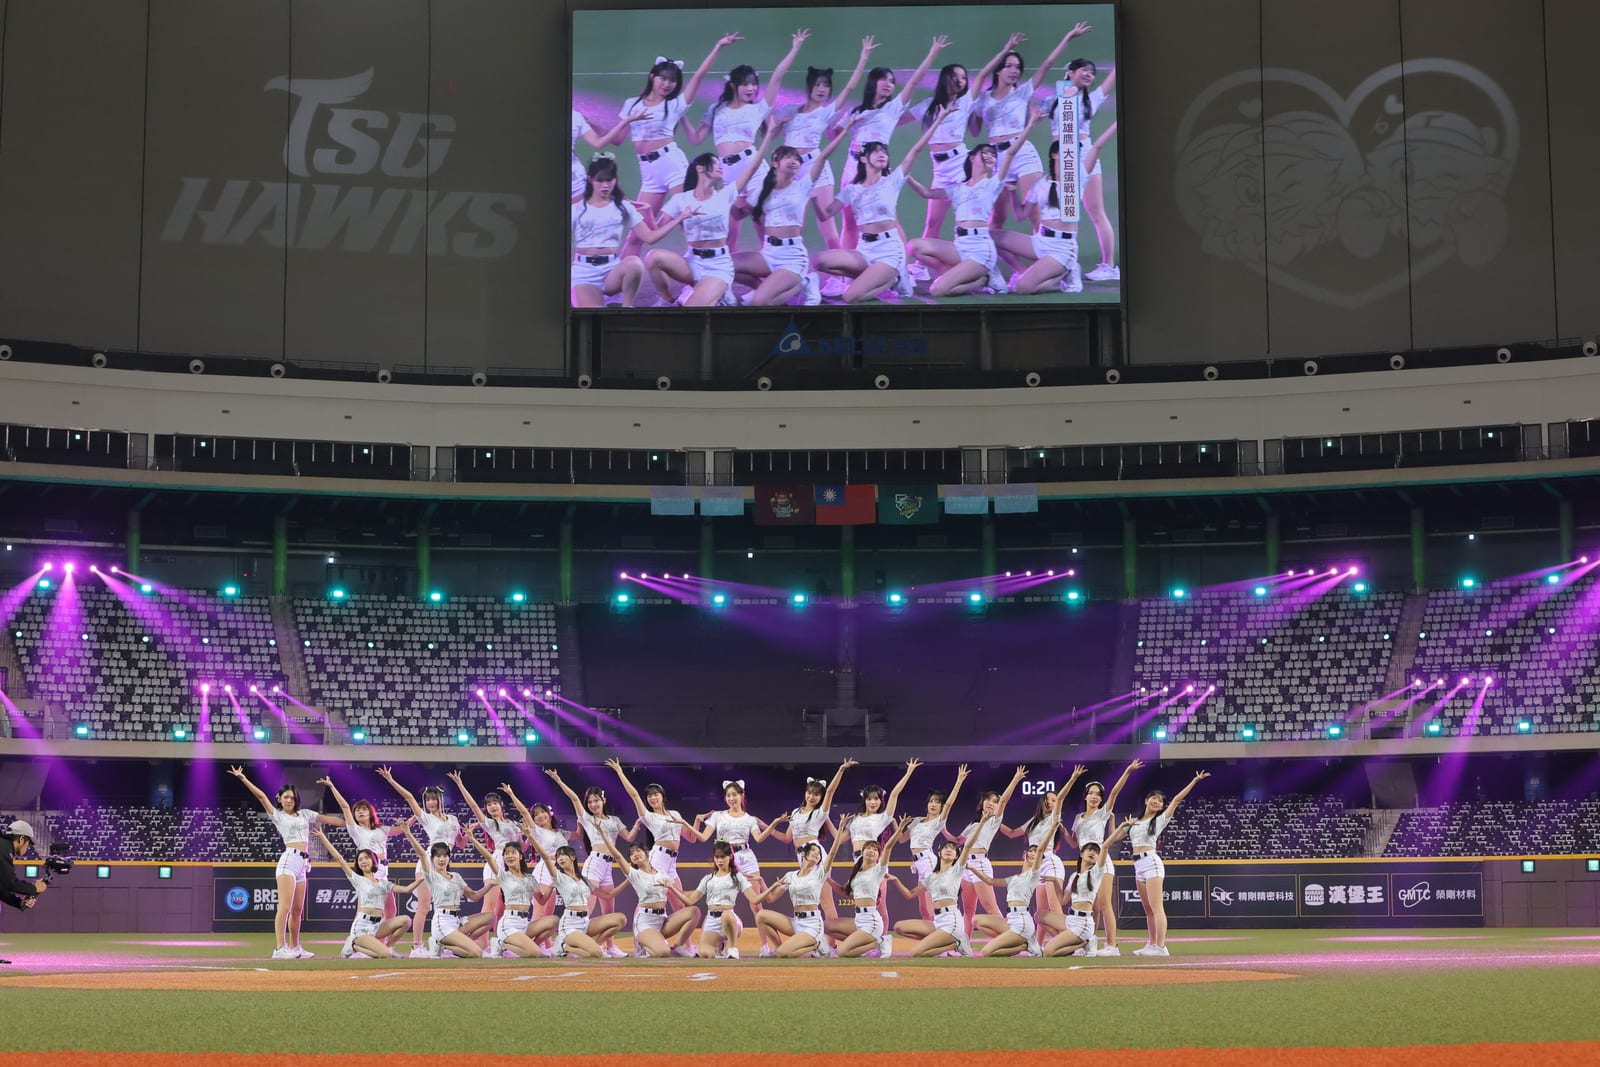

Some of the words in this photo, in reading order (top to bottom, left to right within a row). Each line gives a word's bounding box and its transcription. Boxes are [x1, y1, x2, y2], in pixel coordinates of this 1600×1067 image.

[264, 65, 456, 178] TSG
[1062, 100, 1074, 145] 台鋼雄鷹
[1063, 149, 1075, 217] 大巨蛋戰前報
[160, 177, 527, 258] HAWKS
[1022, 781, 1055, 795] 0:20
[253, 888, 278, 903] BRE
[1120, 889, 1141, 902] TS
[1163, 890, 1202, 901] 台鋼集團
[1328, 885, 1384, 904] 漢堡王
[1398, 889, 1431, 900] GMTC
[1435, 889, 1476, 900] 榮剛材料
